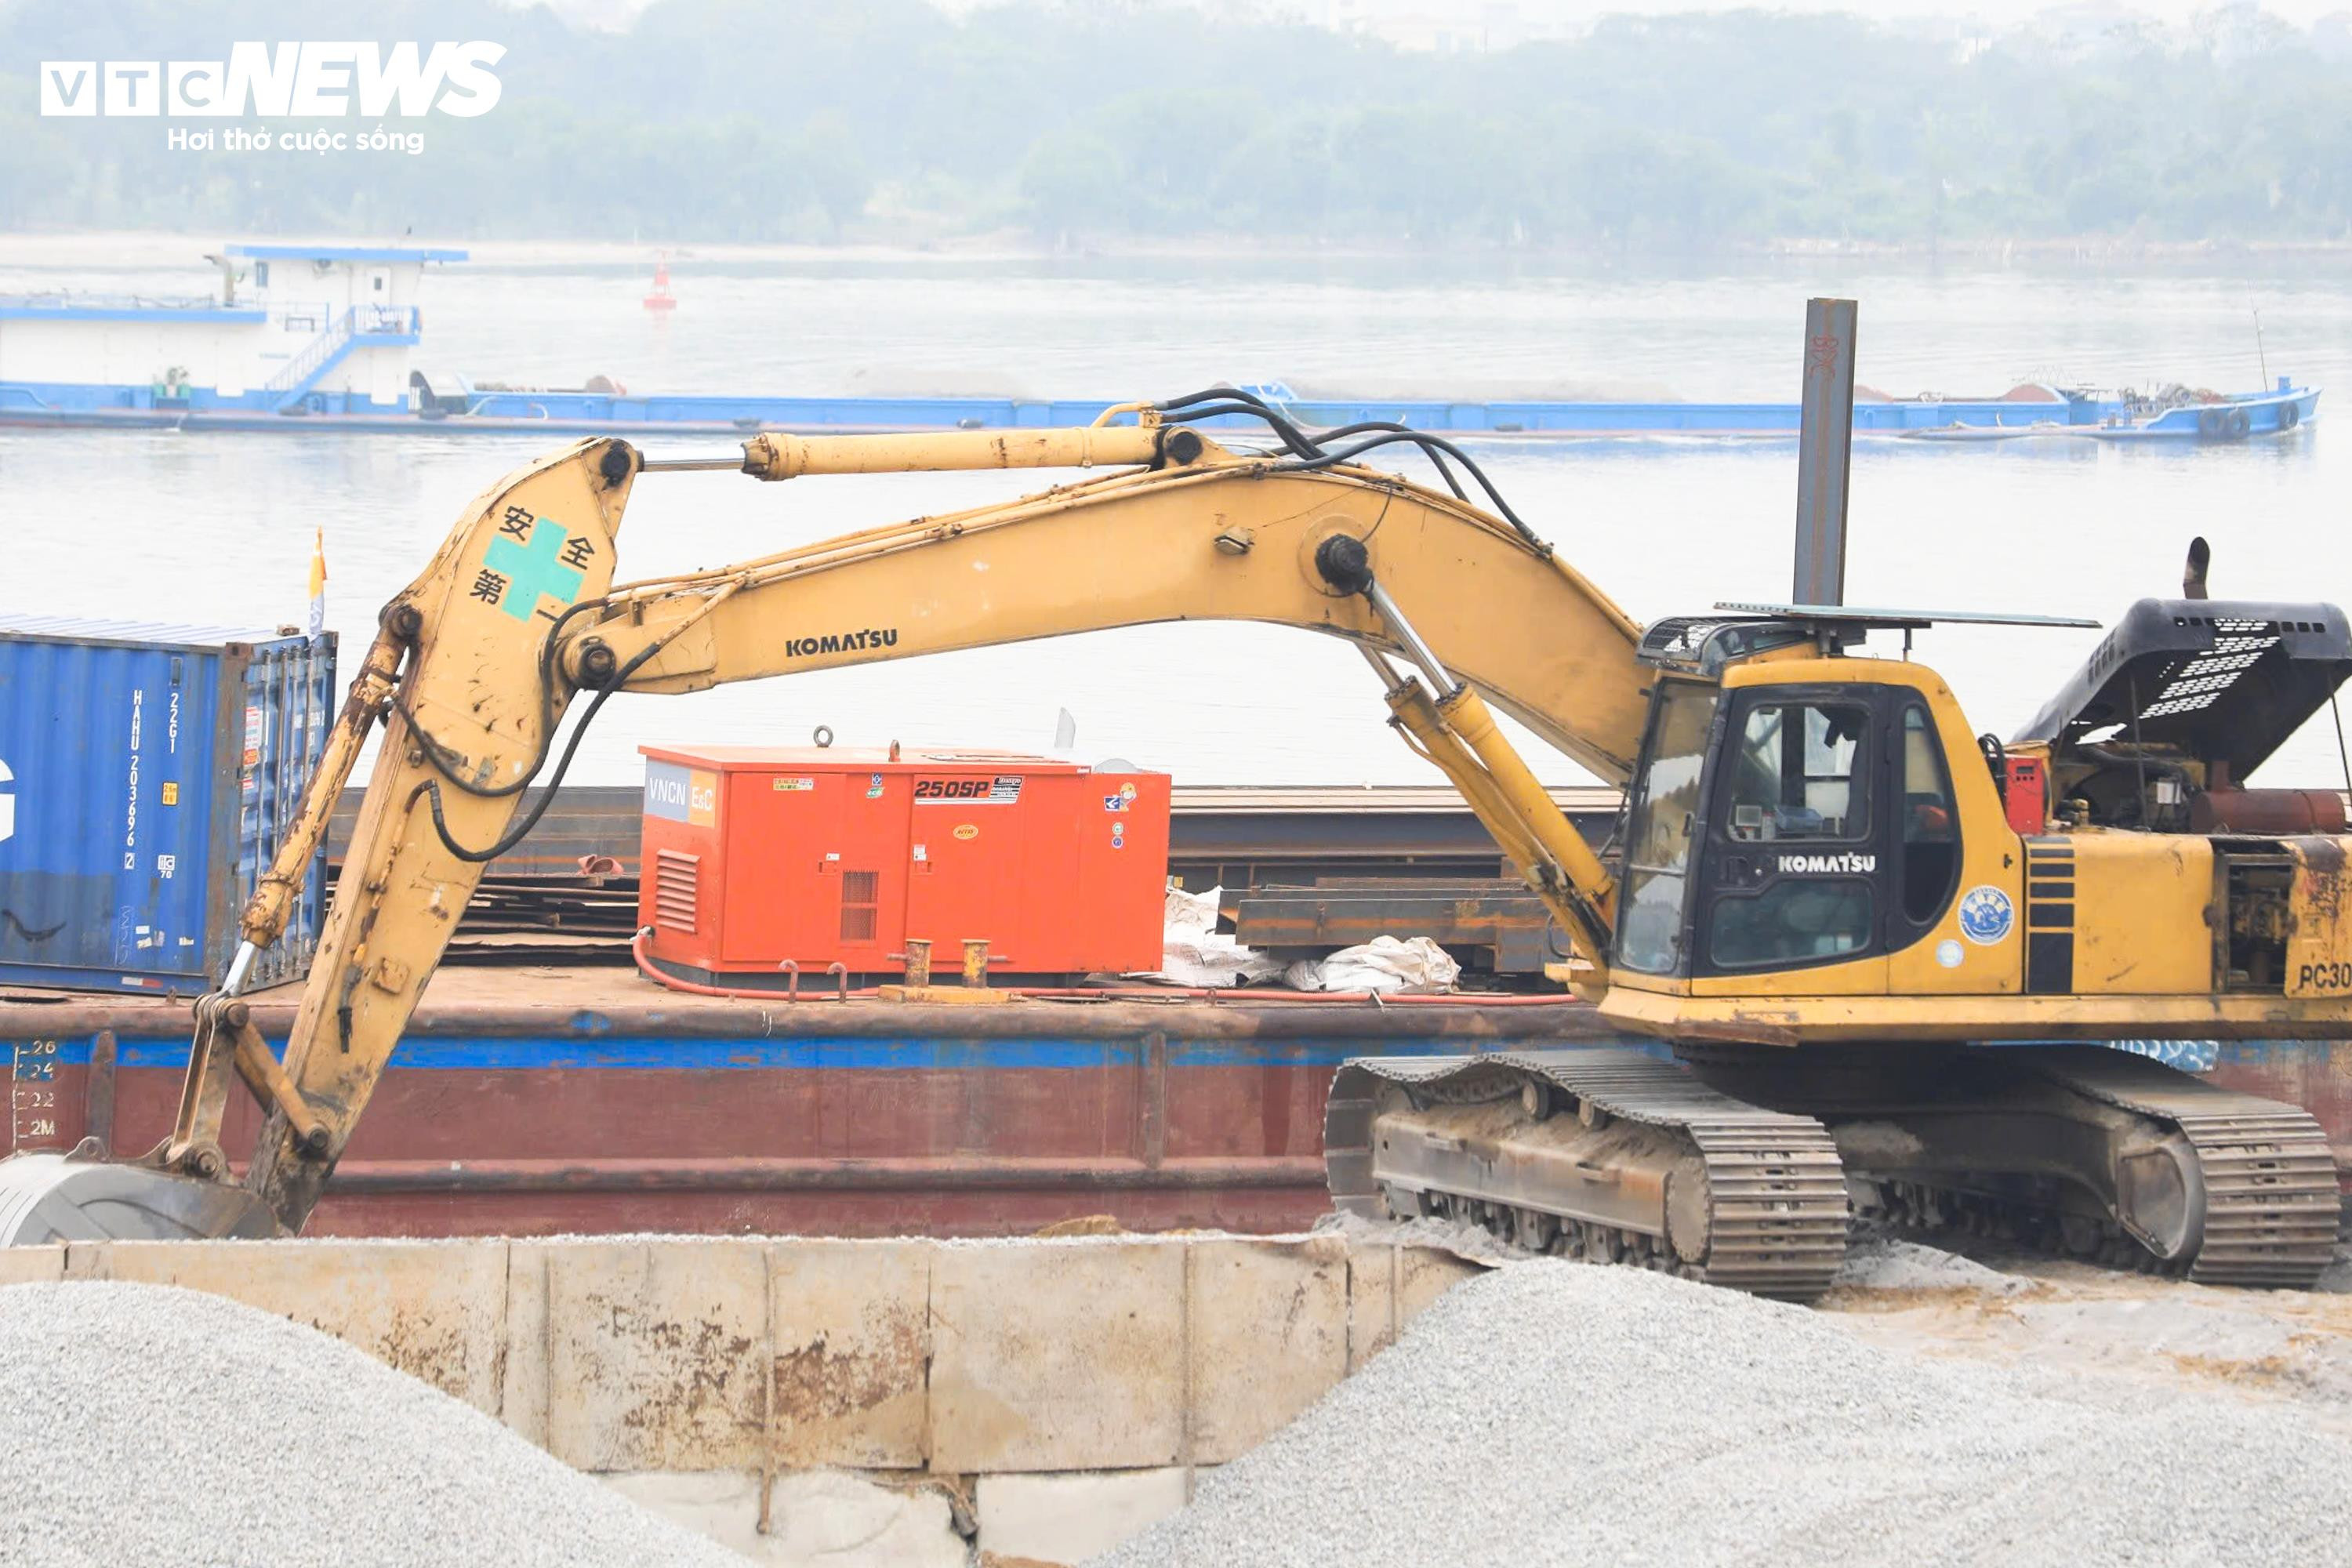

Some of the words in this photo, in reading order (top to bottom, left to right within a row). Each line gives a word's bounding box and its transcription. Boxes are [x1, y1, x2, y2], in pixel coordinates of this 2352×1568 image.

[786, 629, 898, 657] KOMATSU
[131, 689, 143, 750] HAHU
[169, 692, 179, 753] 22G1
[127, 755, 139, 847] 203696
[649, 777, 686, 806] VNCN
[914, 780, 989, 798] 250SP
[1778, 851, 1876, 873] KOMATSU
[32, 1040, 56, 1055] 26
[31, 1091, 55, 1108] 22
[31, 1120, 56, 1136] 2M
